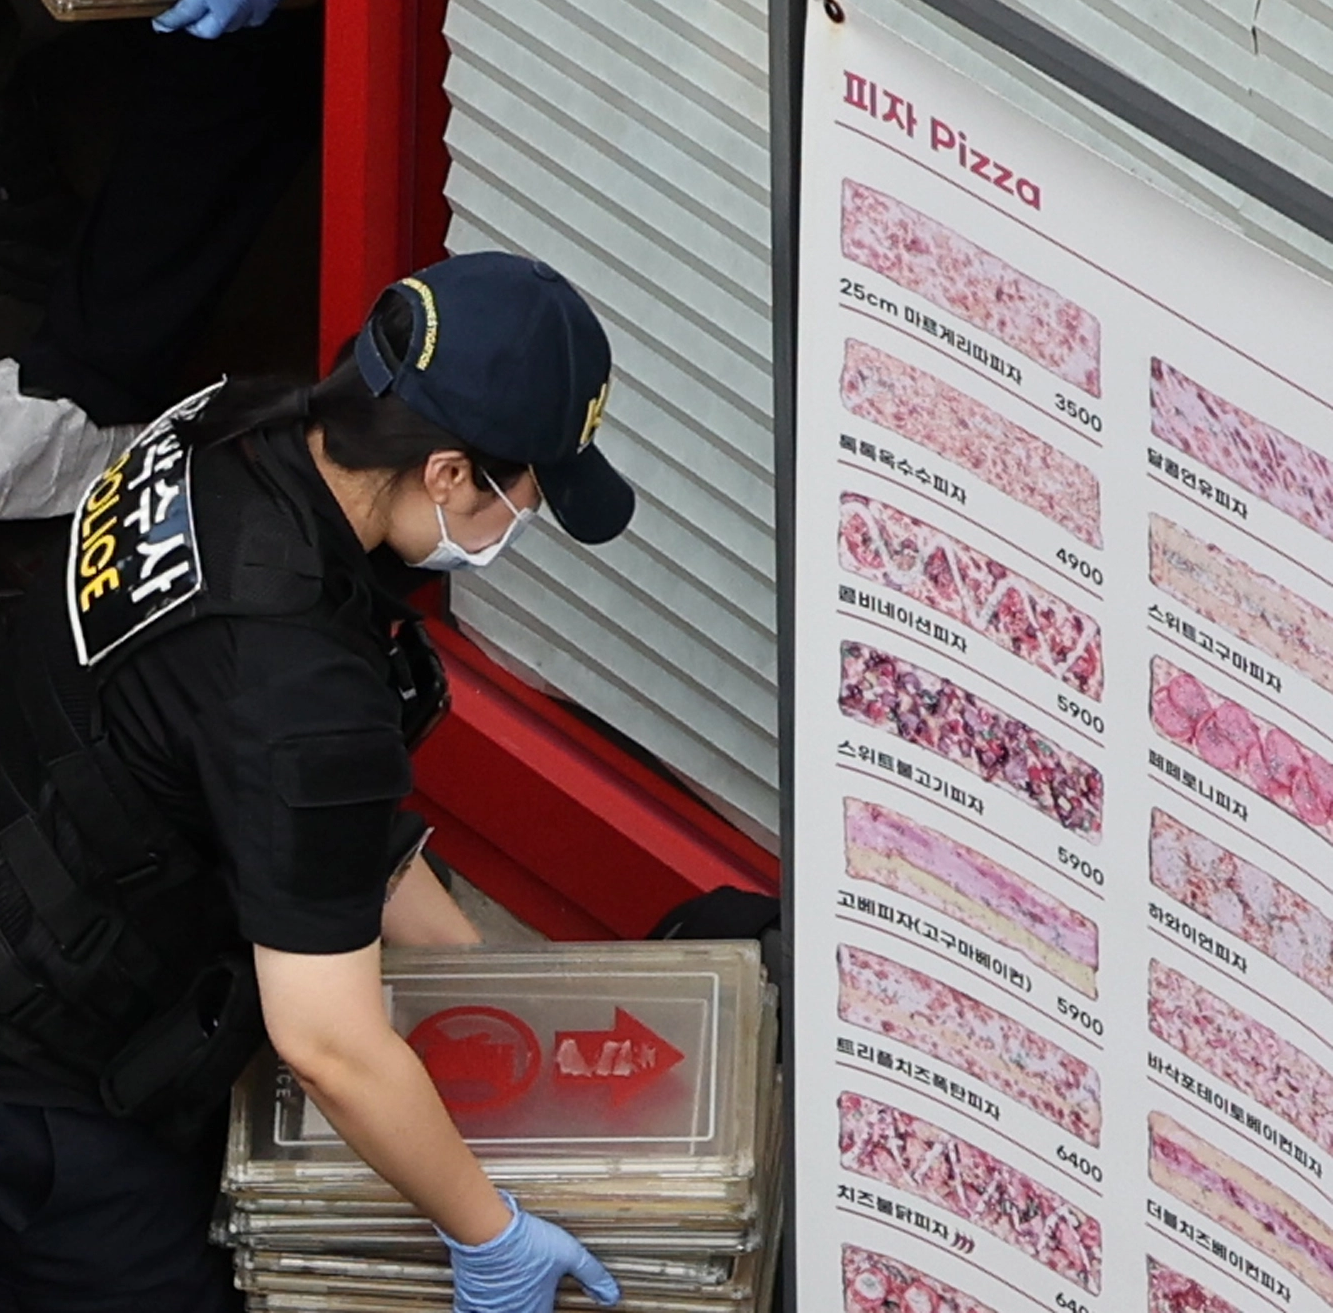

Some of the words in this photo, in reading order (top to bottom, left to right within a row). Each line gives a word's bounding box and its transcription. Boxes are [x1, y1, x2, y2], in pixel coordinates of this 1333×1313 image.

[842, 69, 918, 137] 피자
[930, 116, 1043, 212] Pizza
[839, 277, 899, 317] 25cm
[904, 306, 1023, 386] 마르게리따피자
[1054, 393, 1103, 433] 3500
[838, 434, 968, 506] 톡톡옥수수피자
[1055, 548, 1104, 586] 4900
[1146, 447, 1249, 520] 달콤연유피자
[838, 584, 968, 654] 콤비네이션피자
[1056, 694, 1105, 734] 5900
[1146, 603, 1283, 694] 스위트고구마피자
[837, 739, 985, 816] 스위트불고기피자
[1057, 846, 1105, 886] 5900
[1148, 748, 1249, 822] 페페로니피자
[837, 889, 1033, 993] 고베피자(고구마베이컨)
[1056, 998, 1104, 1036] 5900
[836, 1037, 1001, 1121] 트리플치즈폭탄피자
[1055, 1145, 1104, 1184] 6400
[1147, 1051, 1324, 1180] 바삭포테이토베이컨피자
[837, 1183, 949, 1241] 치즈불닭피자
[1147, 1198, 1292, 1303] 더블치즈베이컨피자
